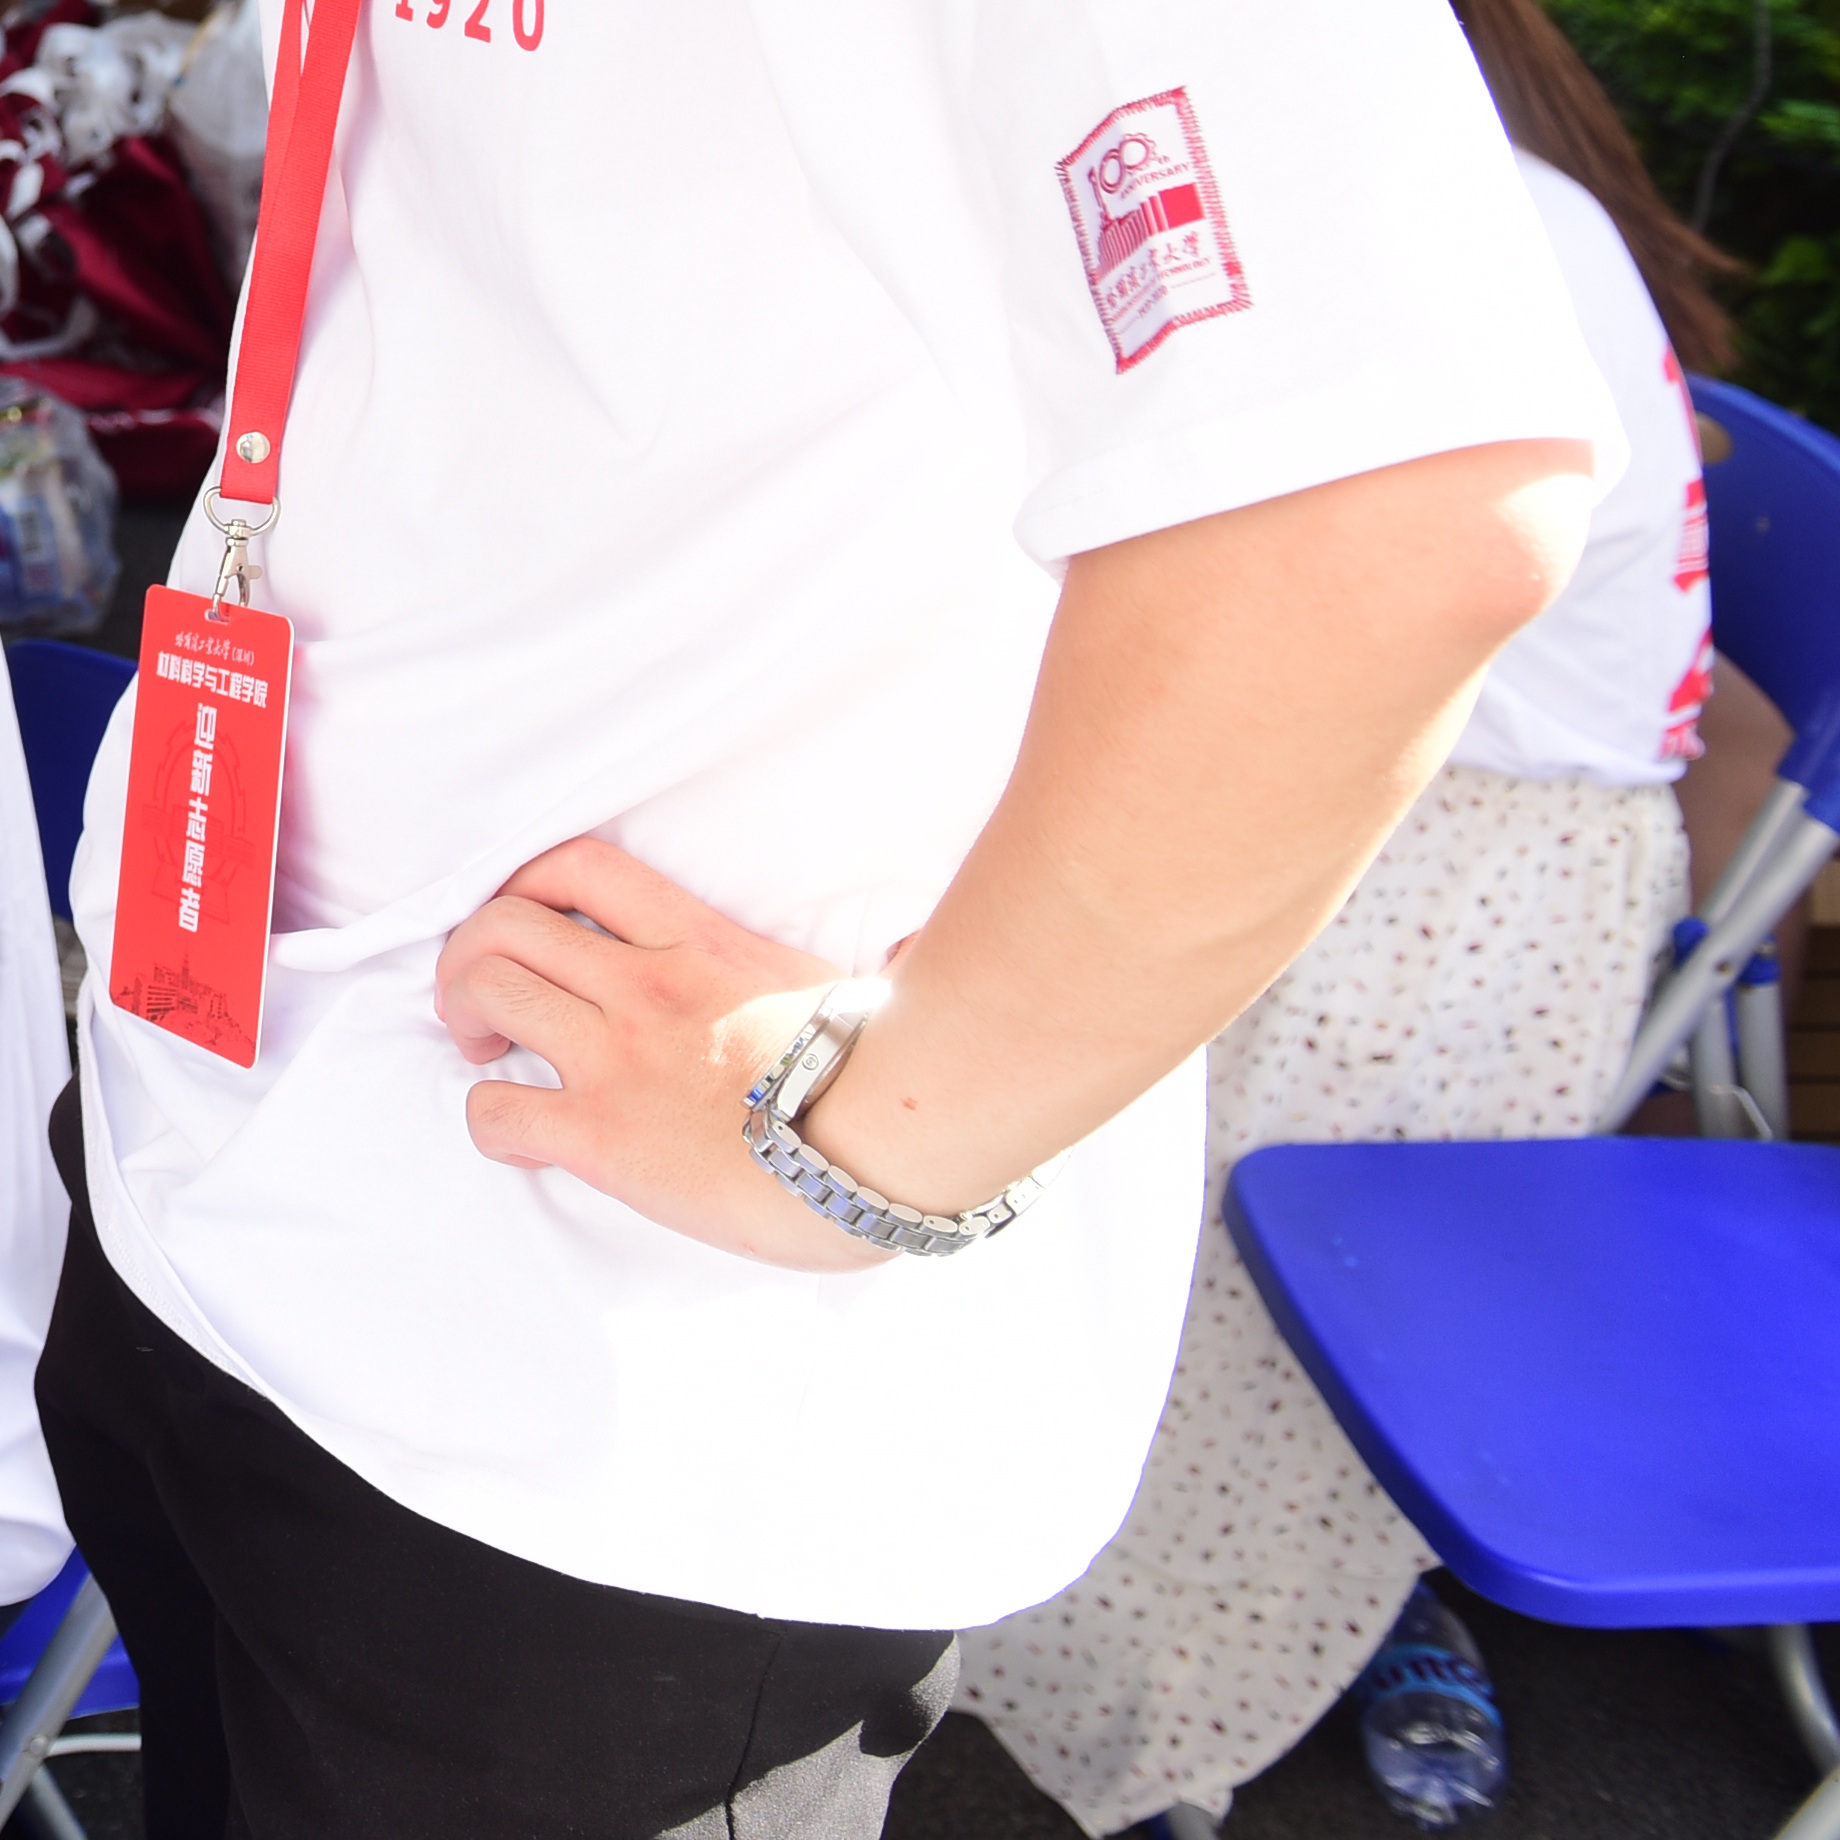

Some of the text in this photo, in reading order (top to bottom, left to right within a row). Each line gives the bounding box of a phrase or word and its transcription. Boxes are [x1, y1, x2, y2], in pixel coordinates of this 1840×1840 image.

[156, 650, 269, 708] 材料科学与工程学院
[178, 702, 218, 933] 迎新志愿者
